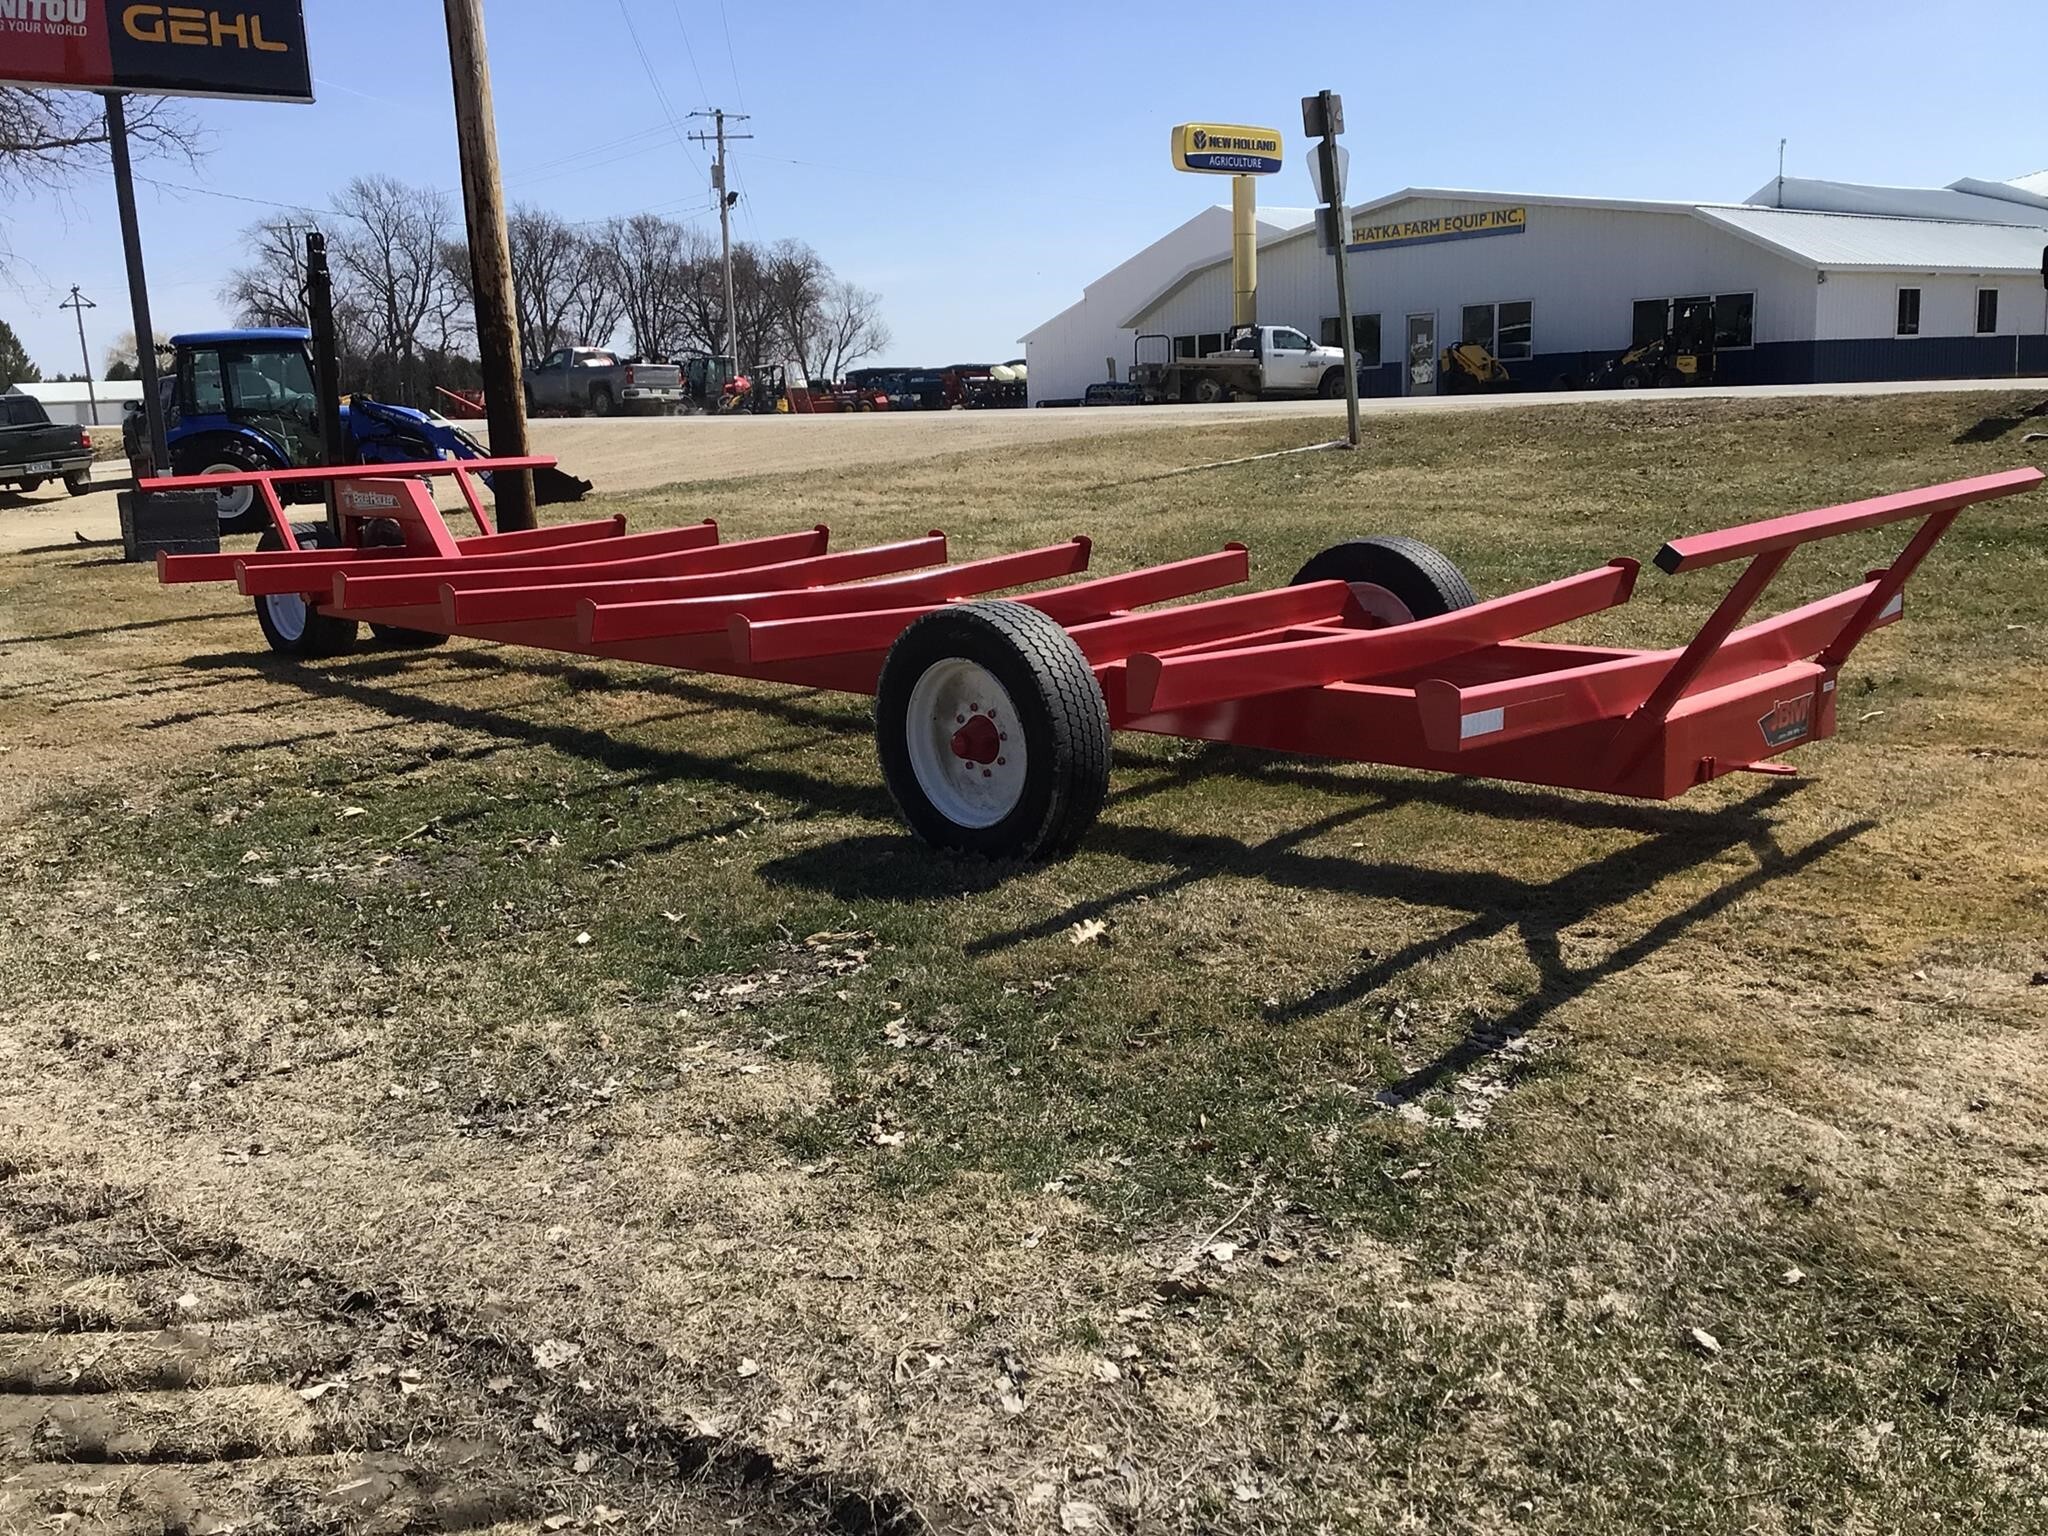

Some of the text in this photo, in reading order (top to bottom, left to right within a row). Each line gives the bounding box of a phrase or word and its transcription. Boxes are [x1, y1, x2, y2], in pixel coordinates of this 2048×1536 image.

[8, 20, 41, 33] YOUR
[44, 23, 88, 37] WORLD
[122, 4, 288, 52] GEHL
[1209, 135, 1277, 152] NEW HOLLAND
[1209, 155, 1262, 169] AGRICULTURE
[1404, 219, 1440, 237] FARM
[1444, 213, 1487, 232] EQUIP
[1491, 209, 1522, 225] INC.
